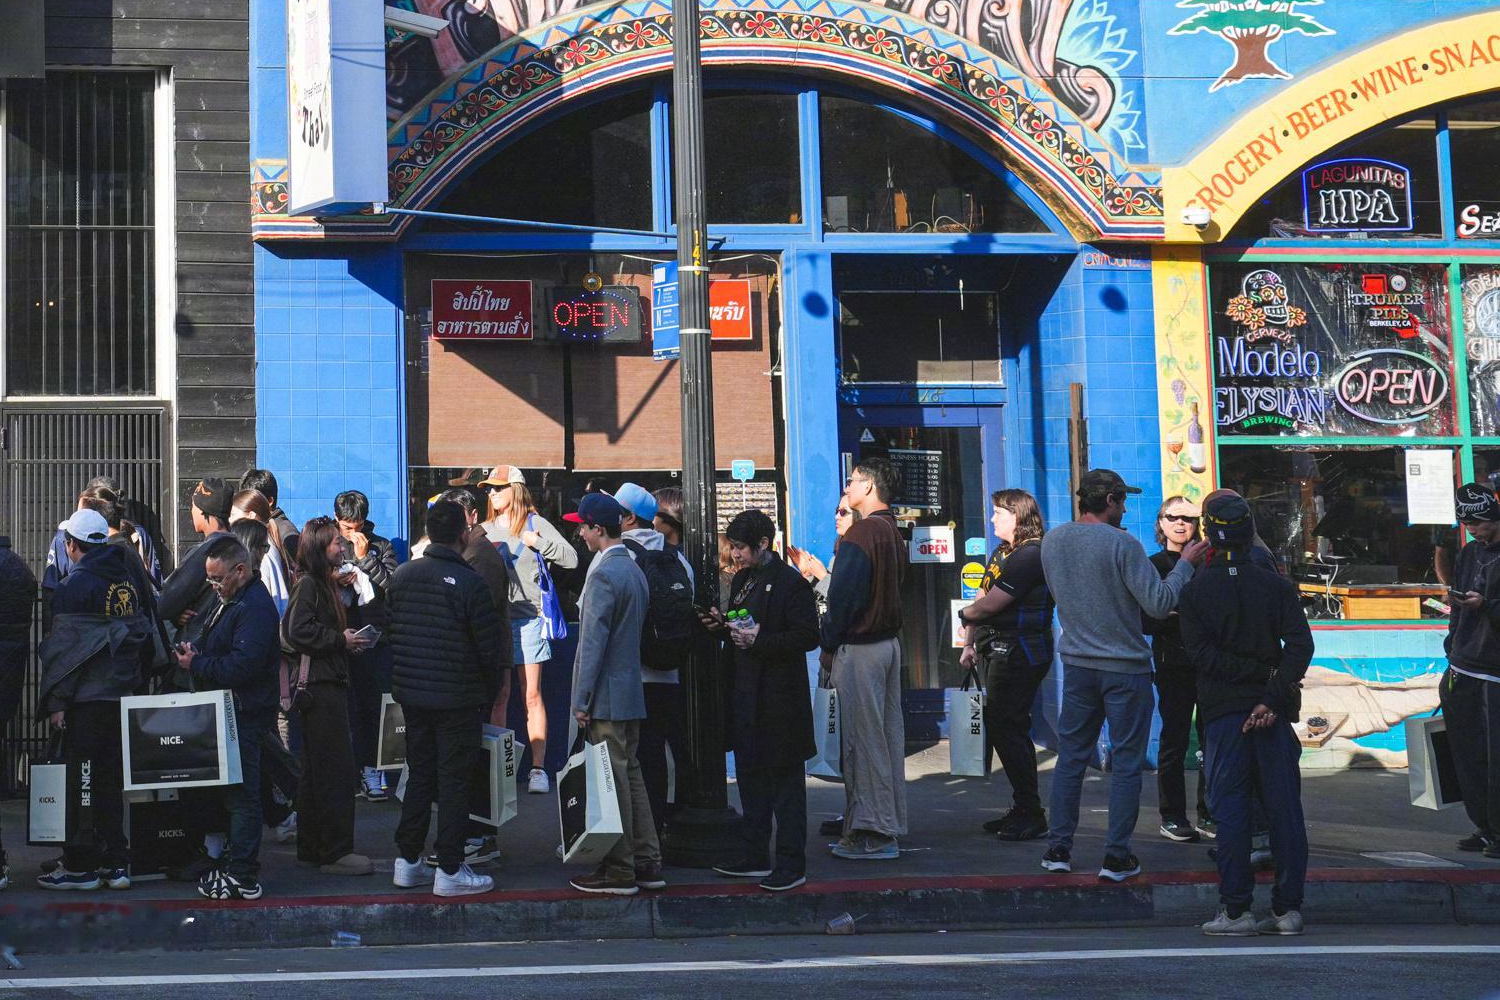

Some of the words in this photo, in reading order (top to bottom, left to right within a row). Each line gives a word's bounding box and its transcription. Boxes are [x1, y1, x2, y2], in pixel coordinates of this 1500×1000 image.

[1286, 88, 1355, 140] BEER
[1352, 56, 1424, 101] WINE
[1311, 165, 1405, 190] LAGUNITAS
[1319, 189, 1399, 224] IPA
[452, 285, 512, 312] ฮิปปี้ไทย
[1352, 293, 1426, 306] TRUMER
[554, 302, 629, 328] OPEN
[709, 301, 745, 321] นรับ
[1218, 336, 1320, 377] Modelo
[1342, 368, 1436, 404] OPEN
[1216, 386, 1325, 426] ELYSIAN
[1242, 414, 1293, 429] BREWING
[919, 544, 948, 555] OPEN
[828, 723, 836, 734] BE
[971, 722, 981, 735] BE
[160, 735, 184, 745] NICE.
[504, 734, 514, 763] NICE.
[82, 760, 91, 790] NICE.
[506, 765, 514, 778] BE
[82, 792, 91, 806] BE
[158, 829, 185, 838] KICKS.
